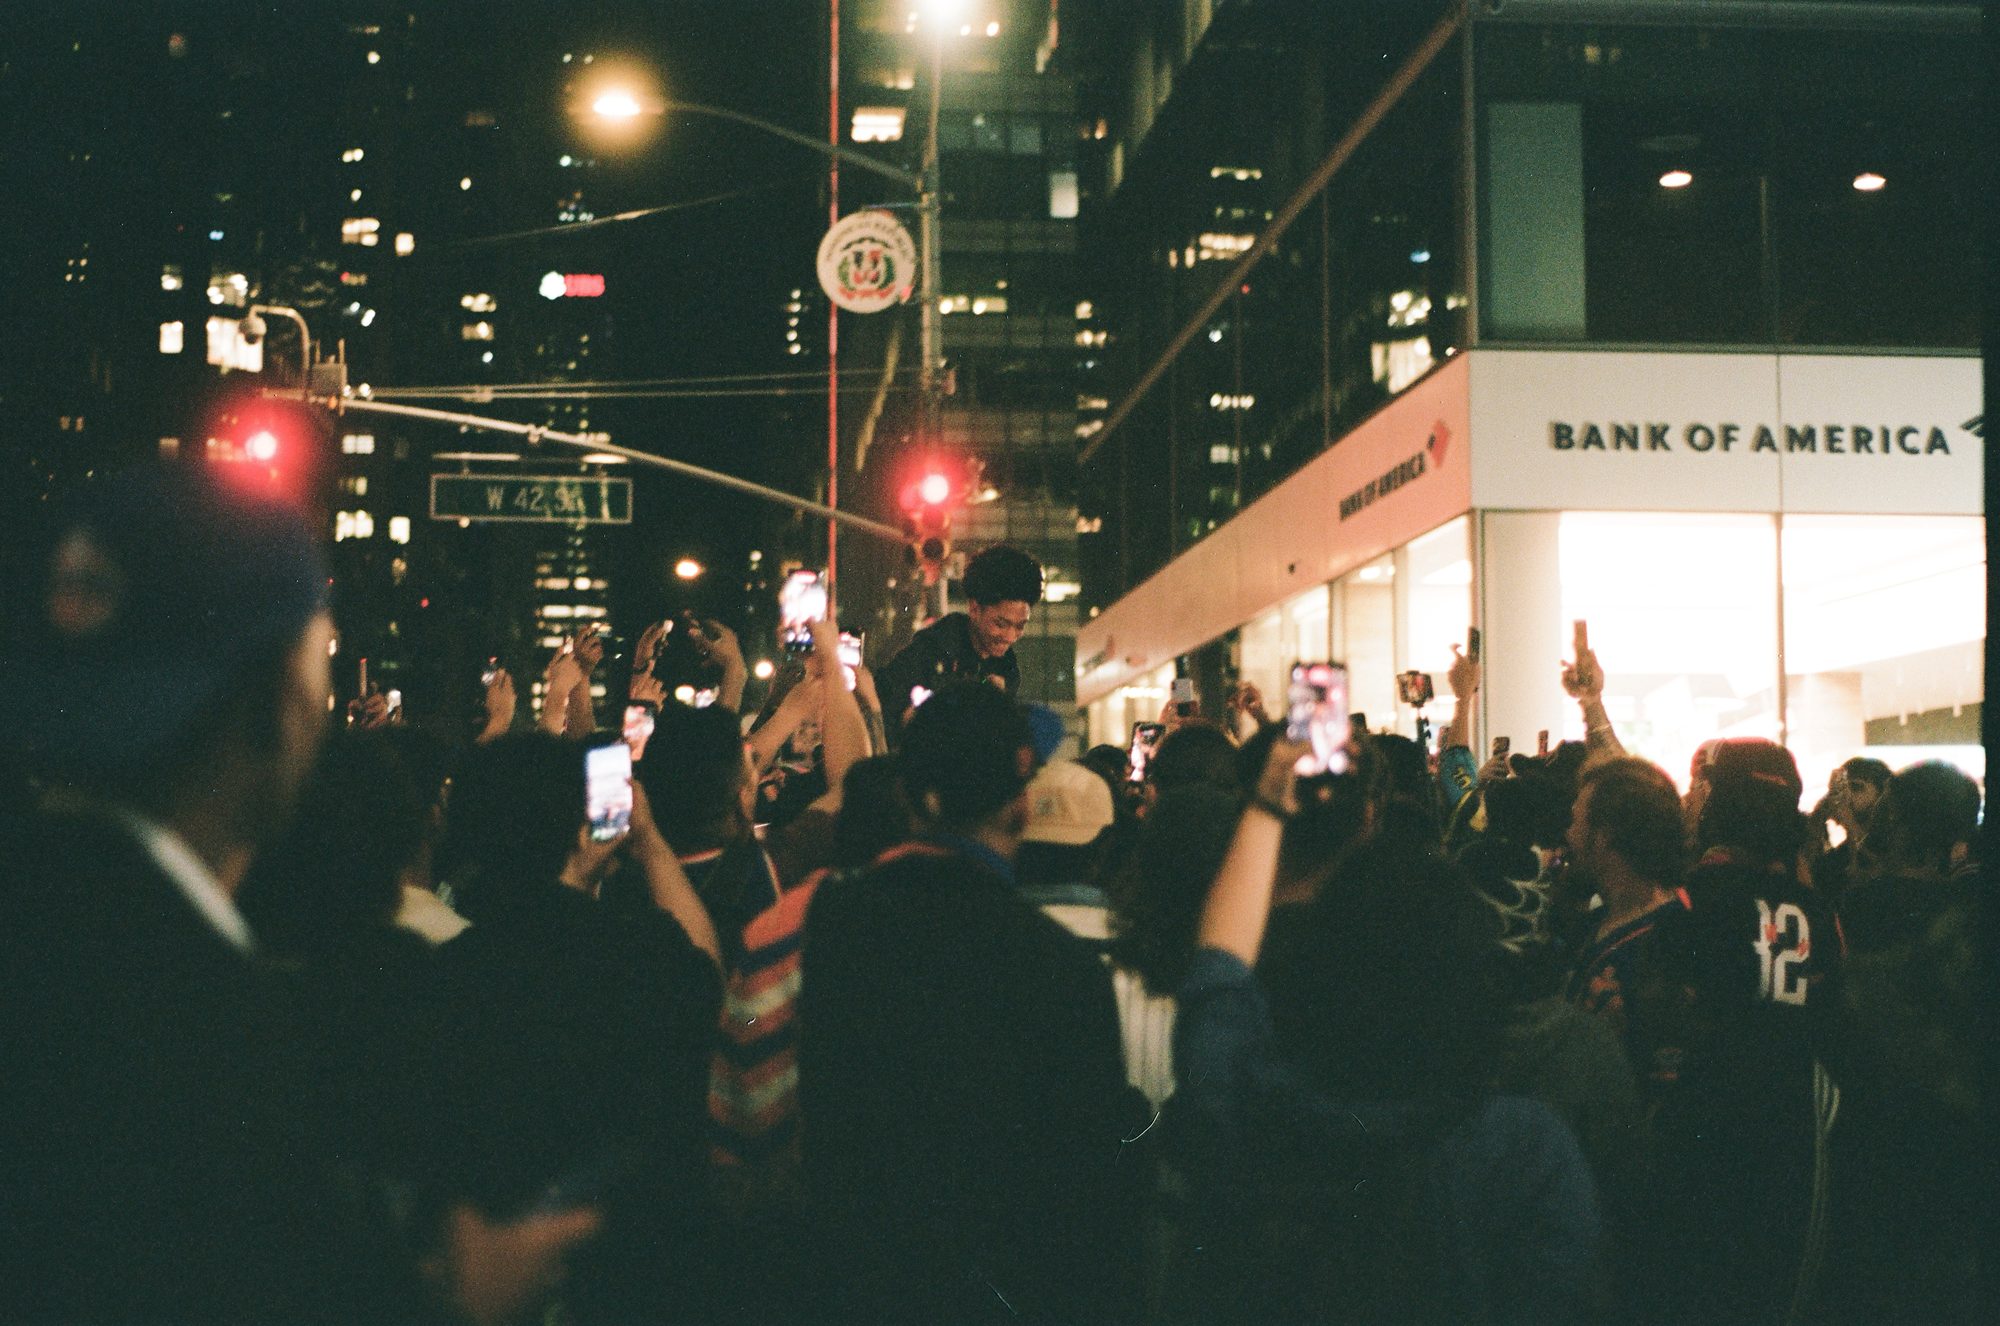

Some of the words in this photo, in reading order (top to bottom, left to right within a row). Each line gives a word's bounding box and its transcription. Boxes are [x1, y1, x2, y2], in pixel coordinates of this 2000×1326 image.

[1549, 421, 1671, 451] BANK
[1684, 422, 1741, 452] OF
[1750, 424, 1951, 455] AMERICA
[486, 486, 504, 511] W
[513, 486, 545, 511] 42
[1751, 898, 1811, 1006] 12
